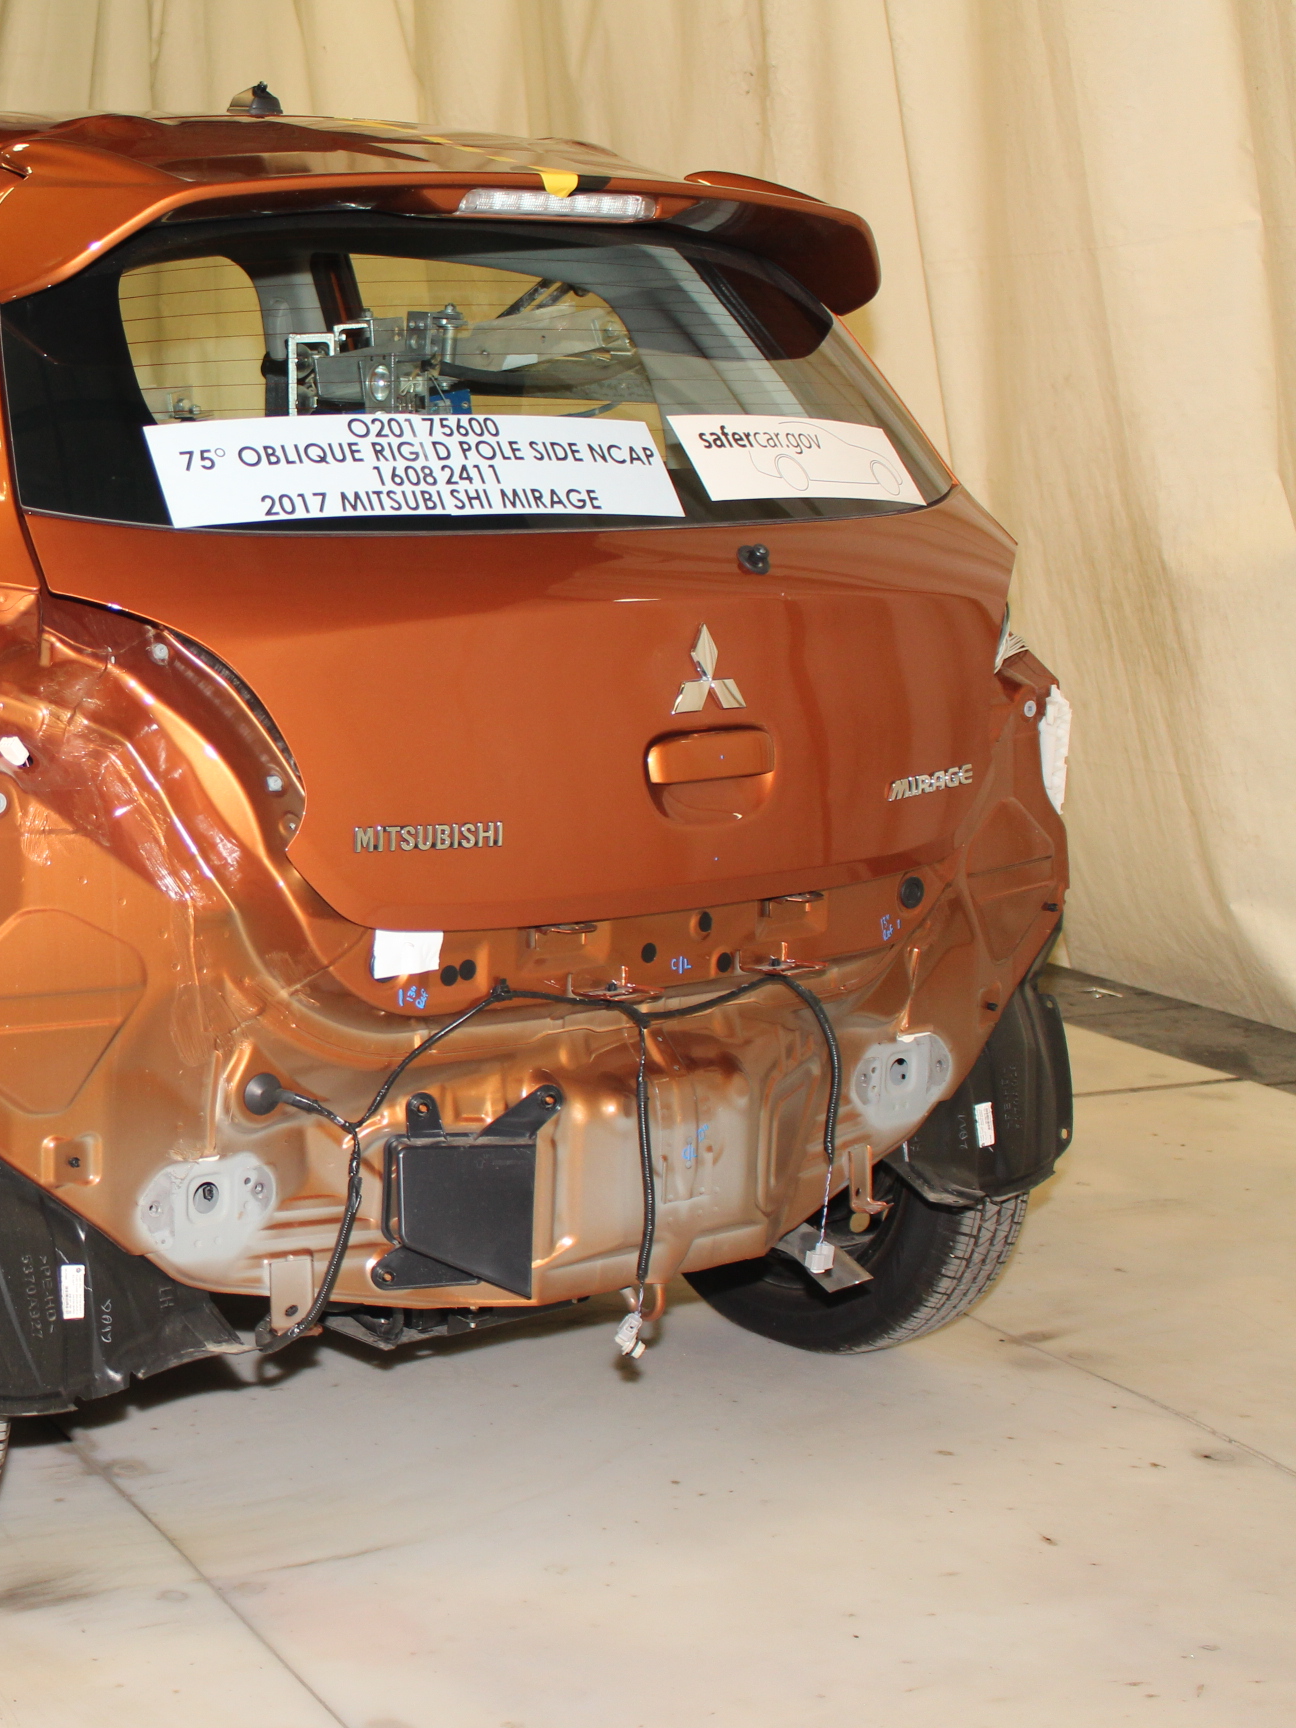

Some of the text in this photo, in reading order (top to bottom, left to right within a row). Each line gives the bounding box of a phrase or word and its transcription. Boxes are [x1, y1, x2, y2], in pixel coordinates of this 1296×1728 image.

[697, 424, 822, 455] safercar.gov
[179, 440, 655, 471] 75° OBLIQUE RIGID POLE SIDE NCAP
[260, 488, 603, 516] 2017 MITSUBISHI MIRAGE
[887, 763, 973, 802] MIRAGE
[354, 820, 503, 853] MITSUBISHI
